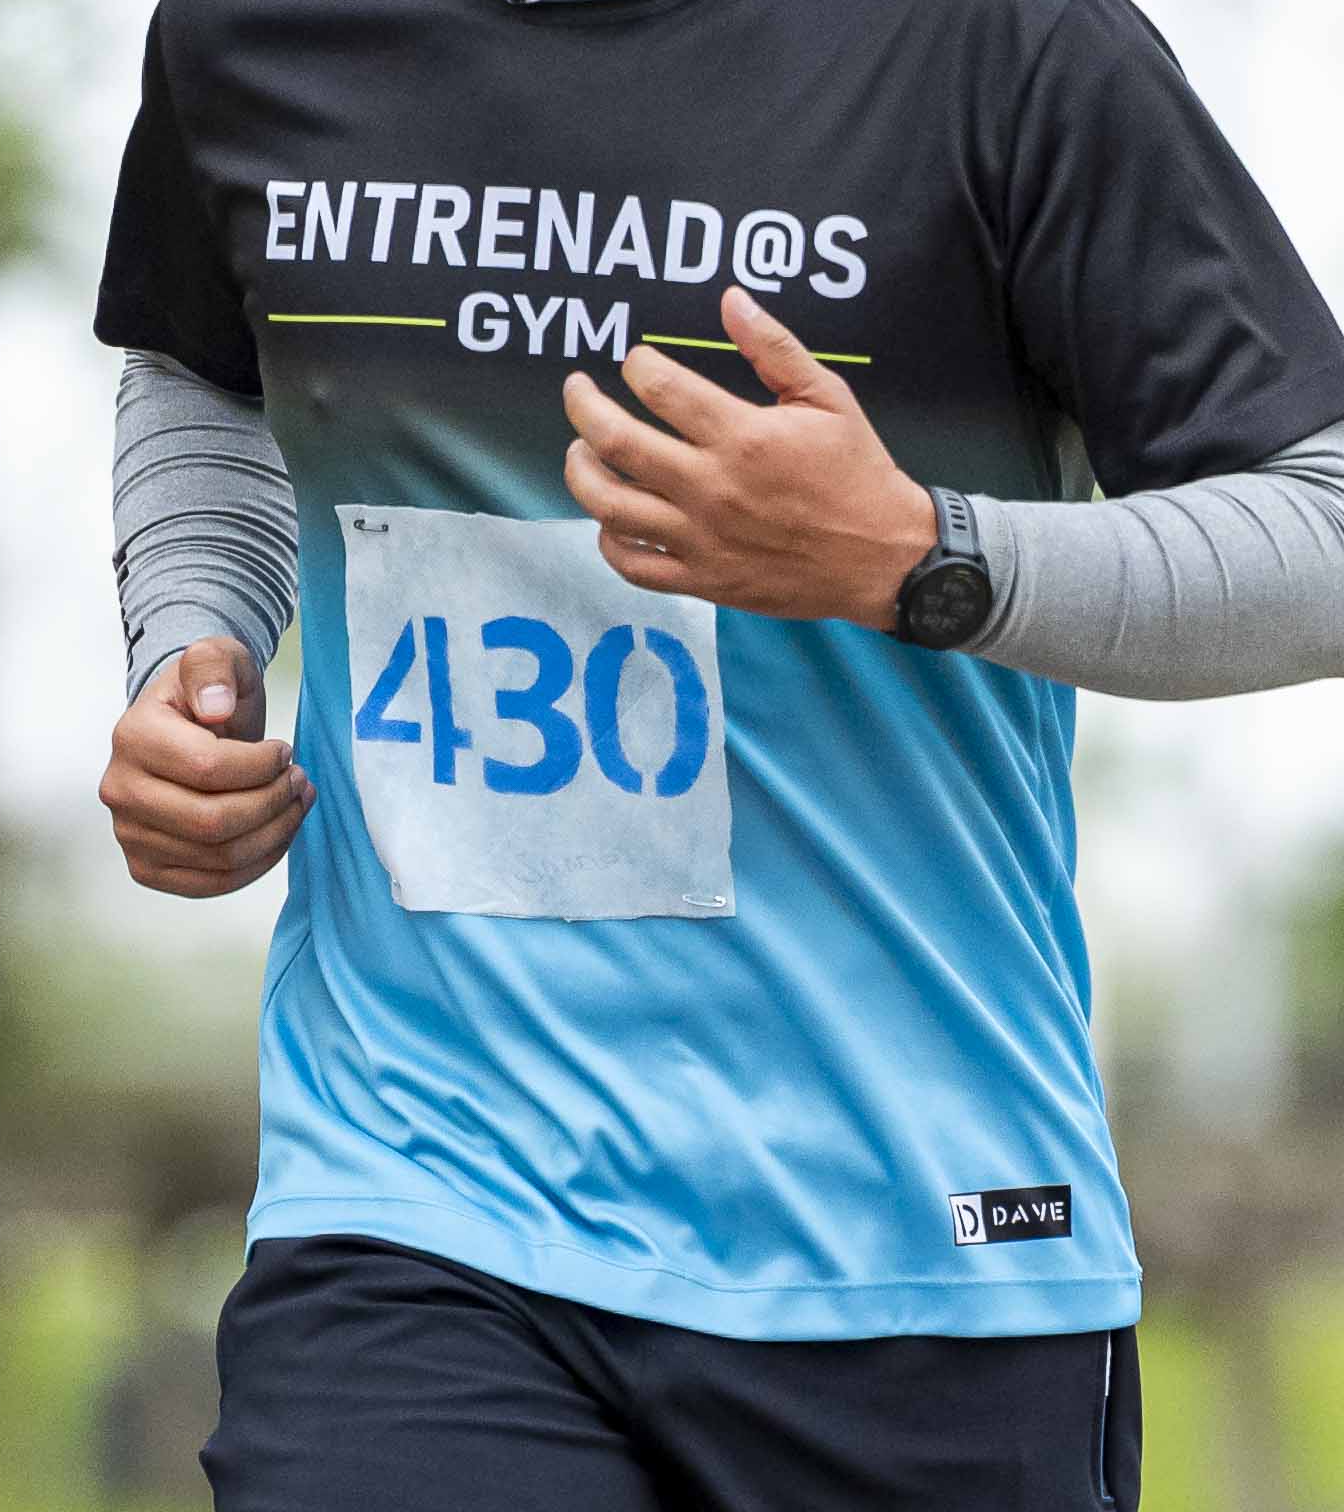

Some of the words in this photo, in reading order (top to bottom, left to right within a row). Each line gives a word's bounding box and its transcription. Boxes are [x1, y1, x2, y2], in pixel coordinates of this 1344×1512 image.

[266, 180, 869, 299] ENTRENAD@S
[457, 292, 629, 362] GYM
[355, 615, 709, 799] 430
[992, 1202, 1064, 1226] DAVE
